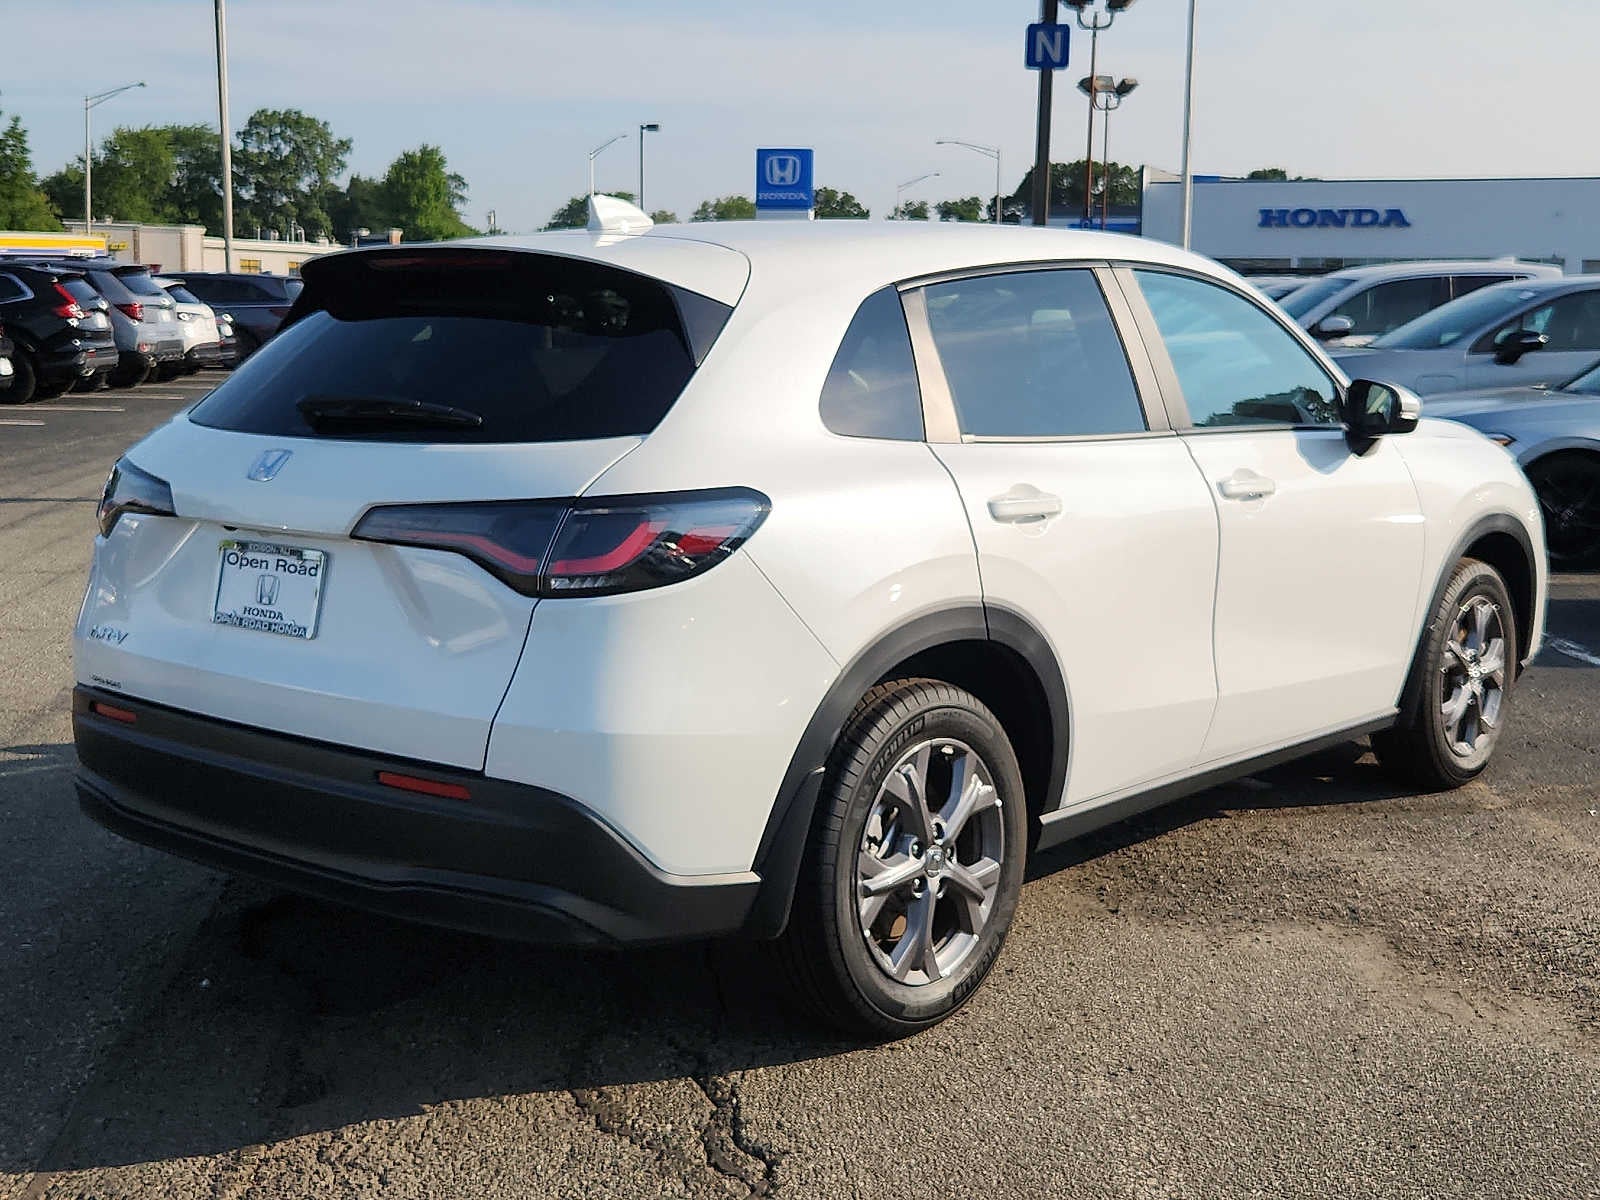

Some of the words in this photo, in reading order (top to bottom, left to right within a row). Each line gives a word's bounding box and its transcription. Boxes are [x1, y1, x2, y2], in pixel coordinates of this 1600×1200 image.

[1035, 31, 1061, 63] N
[758, 192, 809, 201] HONDA
[1257, 208, 1412, 228] HONDA
[226, 551, 269, 570] Open
[275, 558, 319, 577] Road
[243, 606, 284, 621] HONDA
[241, 618, 270, 632] ROAD
[270, 621, 307, 638] HONDA
